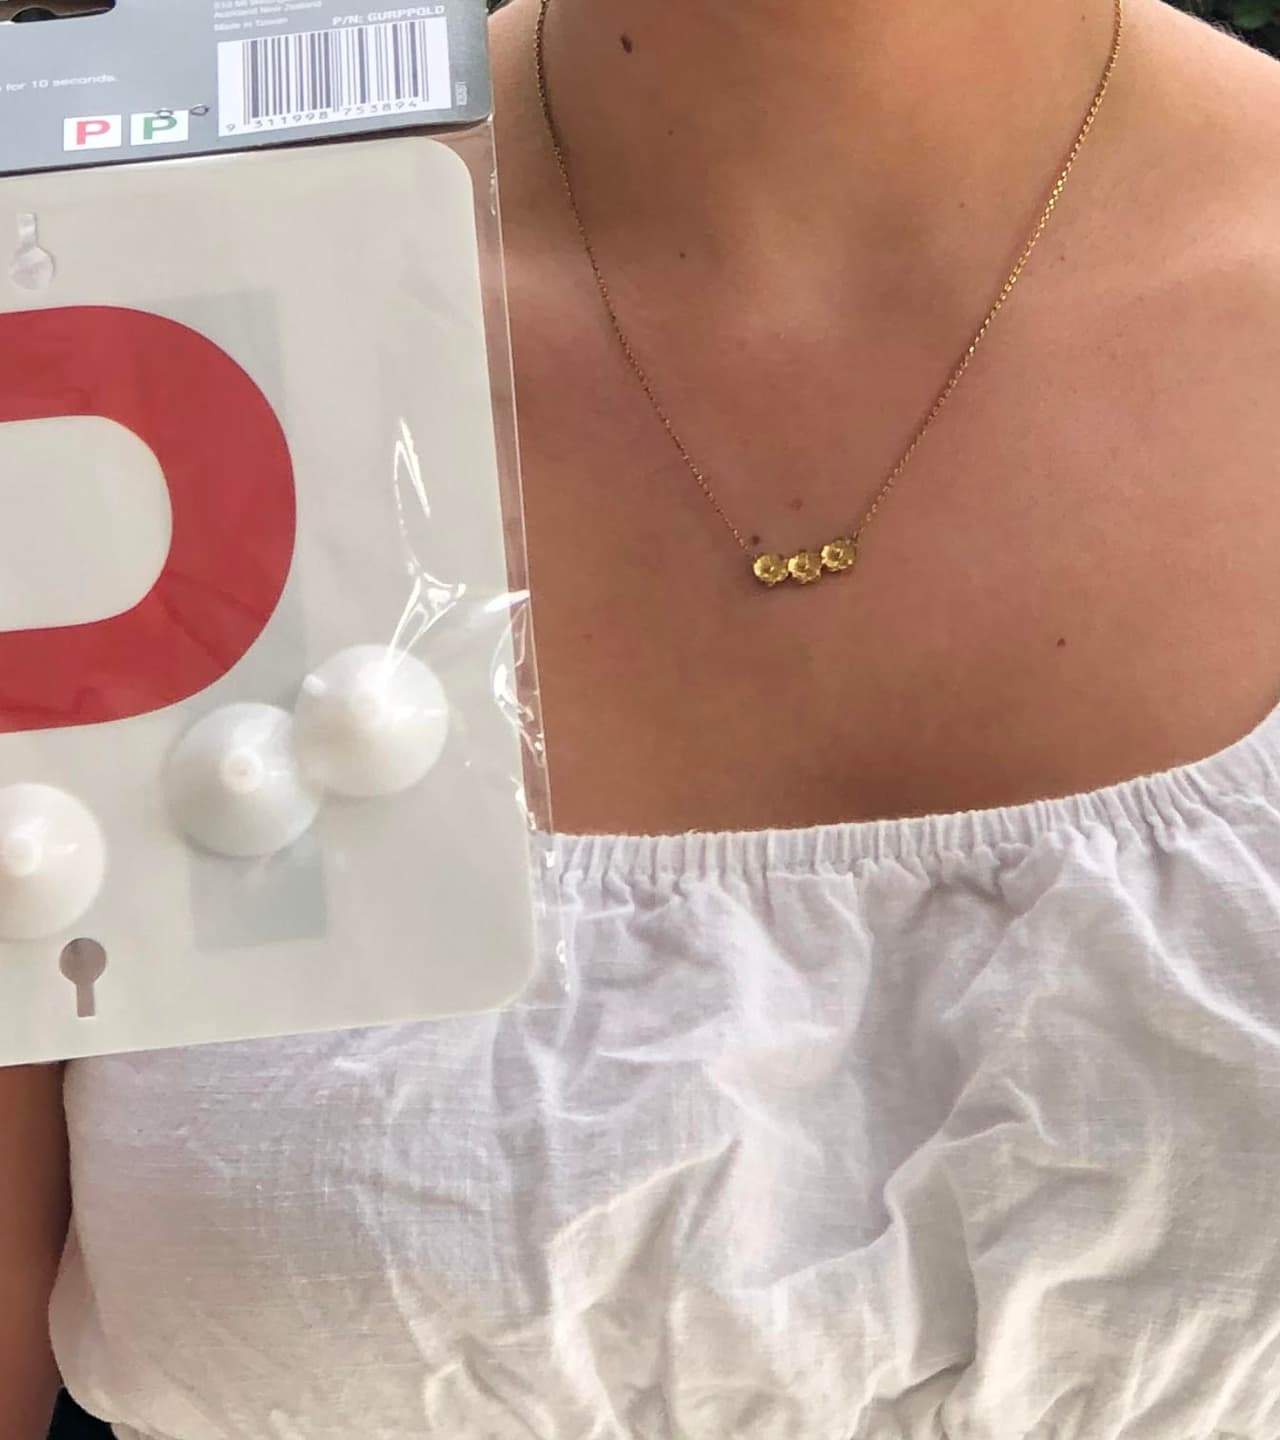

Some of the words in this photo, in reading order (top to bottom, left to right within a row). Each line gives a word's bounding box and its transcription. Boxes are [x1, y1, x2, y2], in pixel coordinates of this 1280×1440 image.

[6, 81, 26, 92] for
[31, 79, 49, 89] 10
[254, 110, 329, 129] 311998
[344, 100, 418, 117] 753894
[76, 120, 111, 145] P
[143, 114, 178, 140] P
